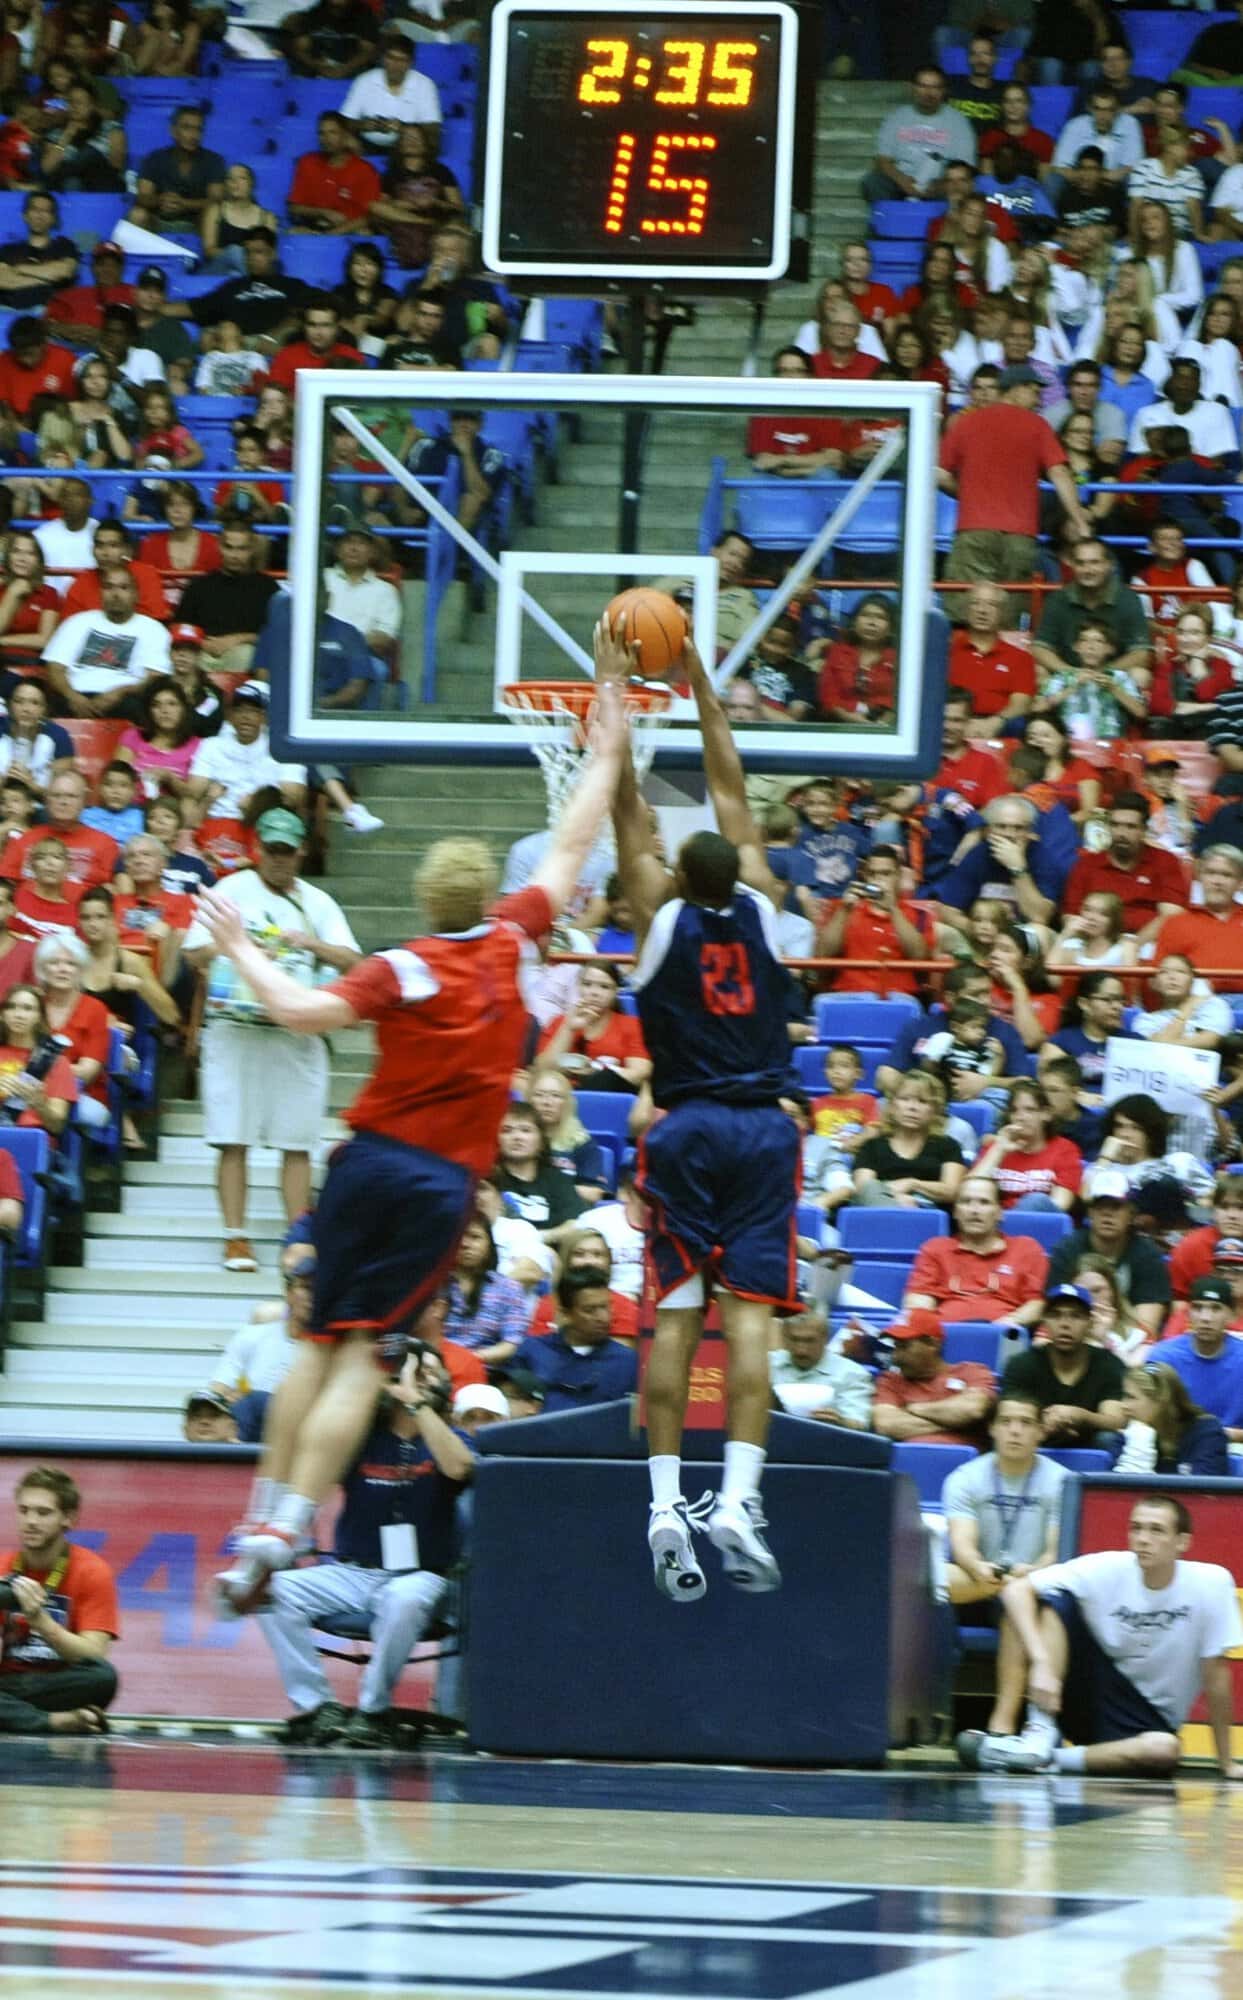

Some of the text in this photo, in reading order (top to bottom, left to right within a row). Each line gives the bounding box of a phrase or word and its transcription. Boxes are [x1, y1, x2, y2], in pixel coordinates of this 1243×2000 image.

[579, 41, 757, 104] 2:35
[606, 134, 716, 233] 15
[700, 943, 756, 1017] 23
